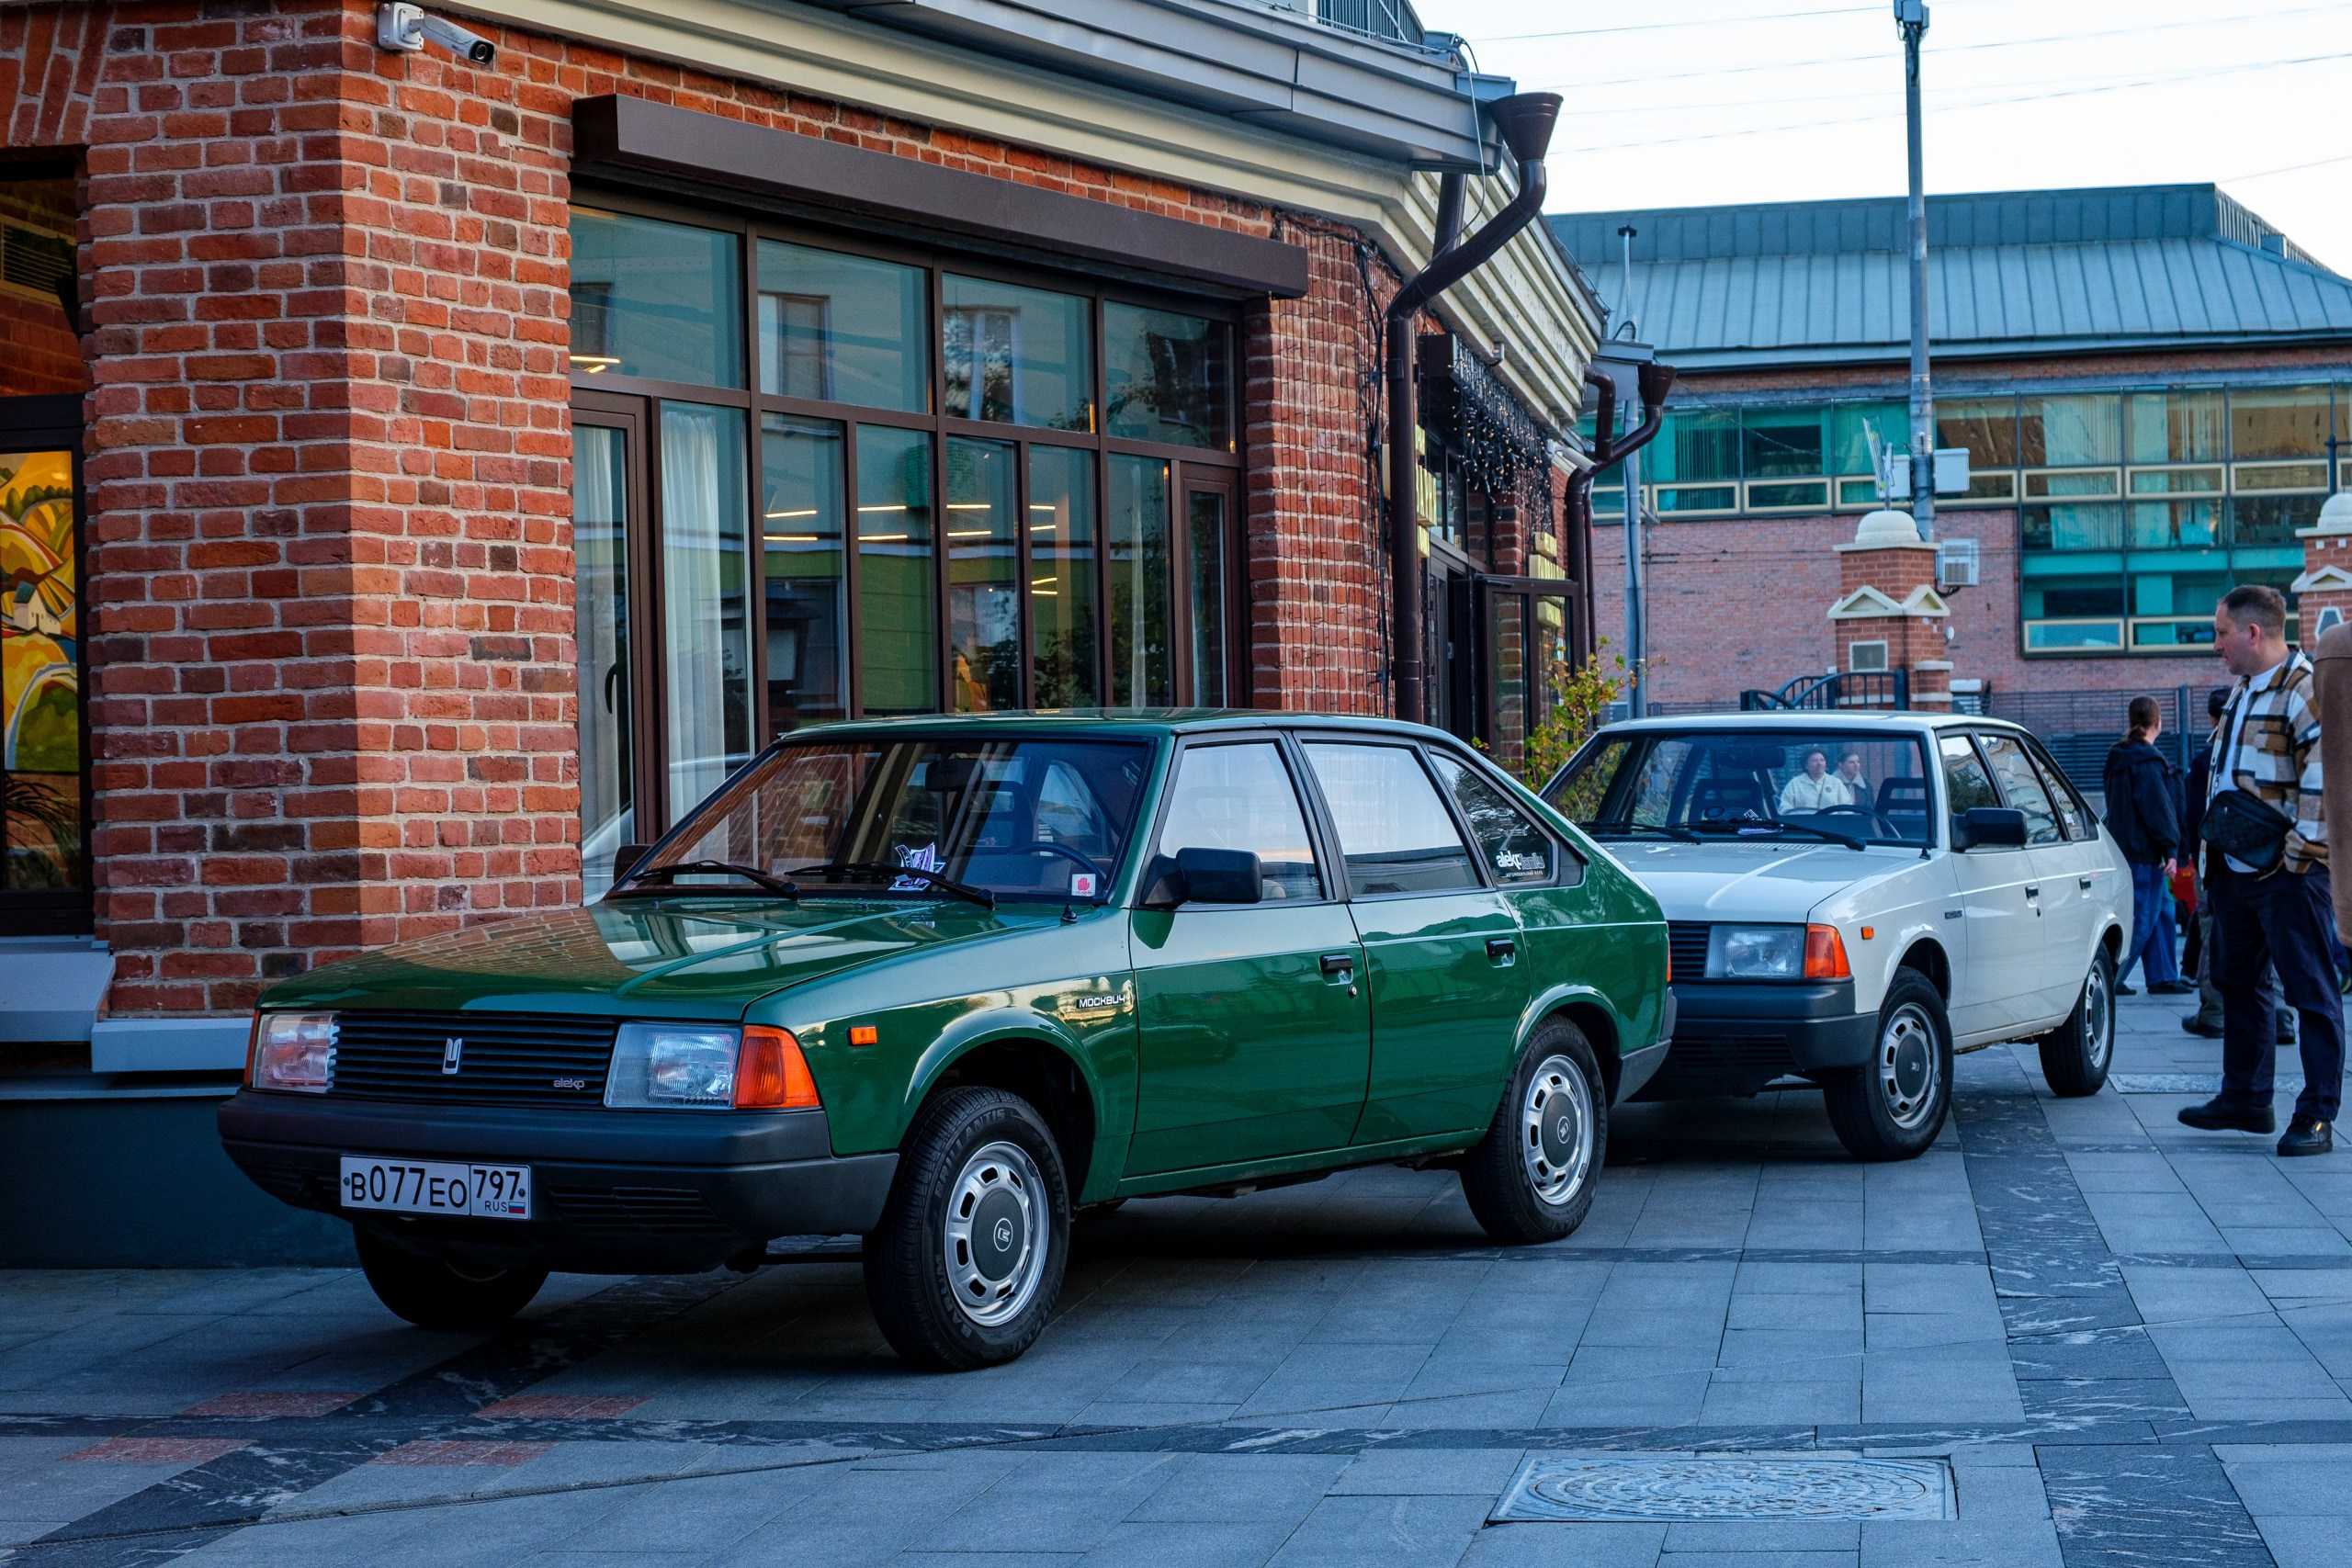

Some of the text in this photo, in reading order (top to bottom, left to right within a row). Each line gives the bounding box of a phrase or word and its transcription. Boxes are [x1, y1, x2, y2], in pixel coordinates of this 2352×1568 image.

[553, 1077, 585, 1090] aleko
[473, 1168, 521, 1201] 797
[484, 1200, 508, 1213] RUS
